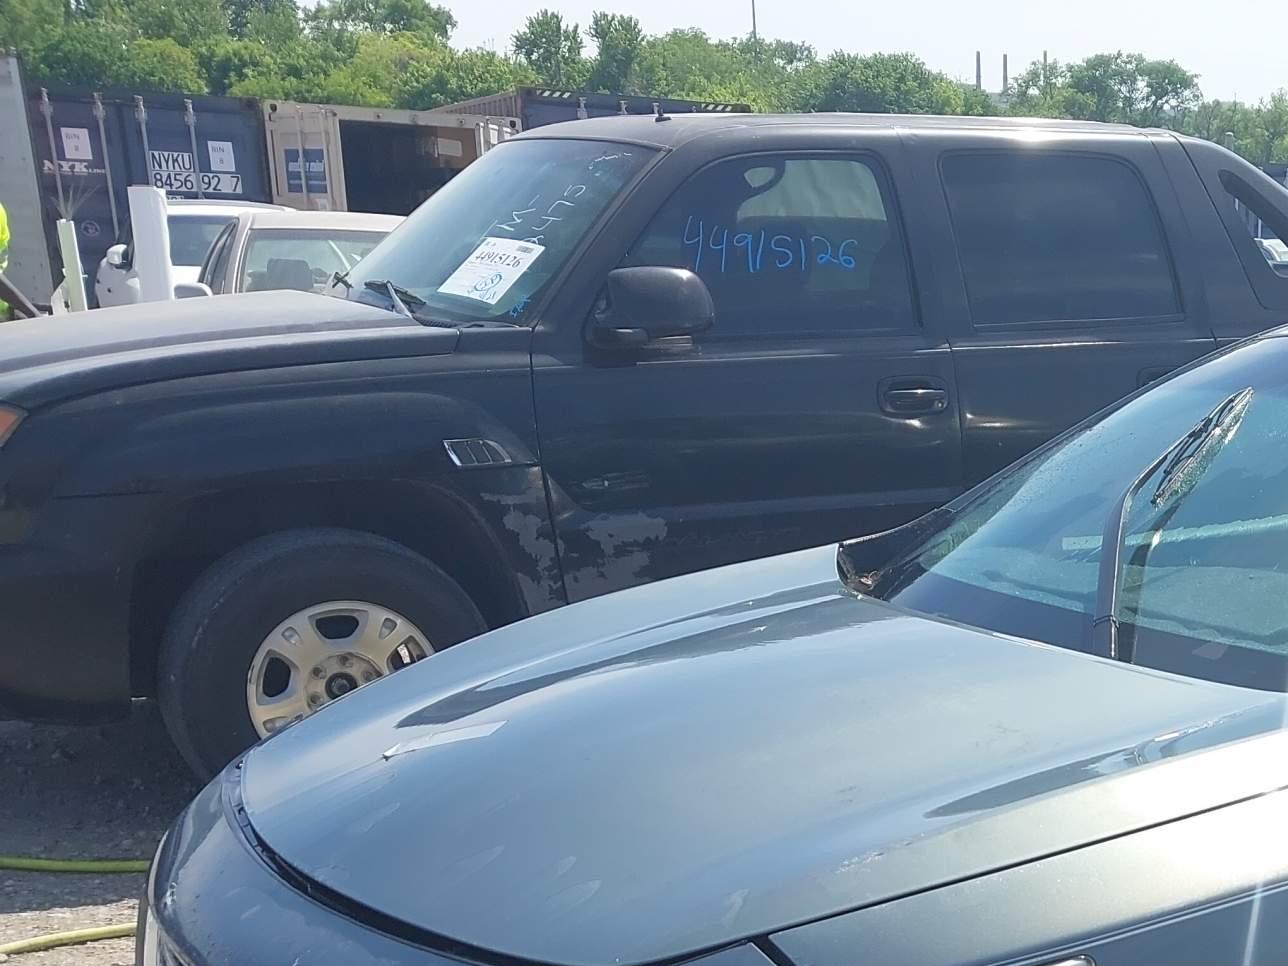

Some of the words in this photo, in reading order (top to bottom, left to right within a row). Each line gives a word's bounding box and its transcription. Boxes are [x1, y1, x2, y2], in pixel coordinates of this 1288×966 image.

[43, 160, 88, 171] NYK
[151, 152, 192, 171] NYKU
[230, 175, 241, 193] 7
[683, 215, 858, 273] 44915126
[475, 250, 522, 268] 44915126
